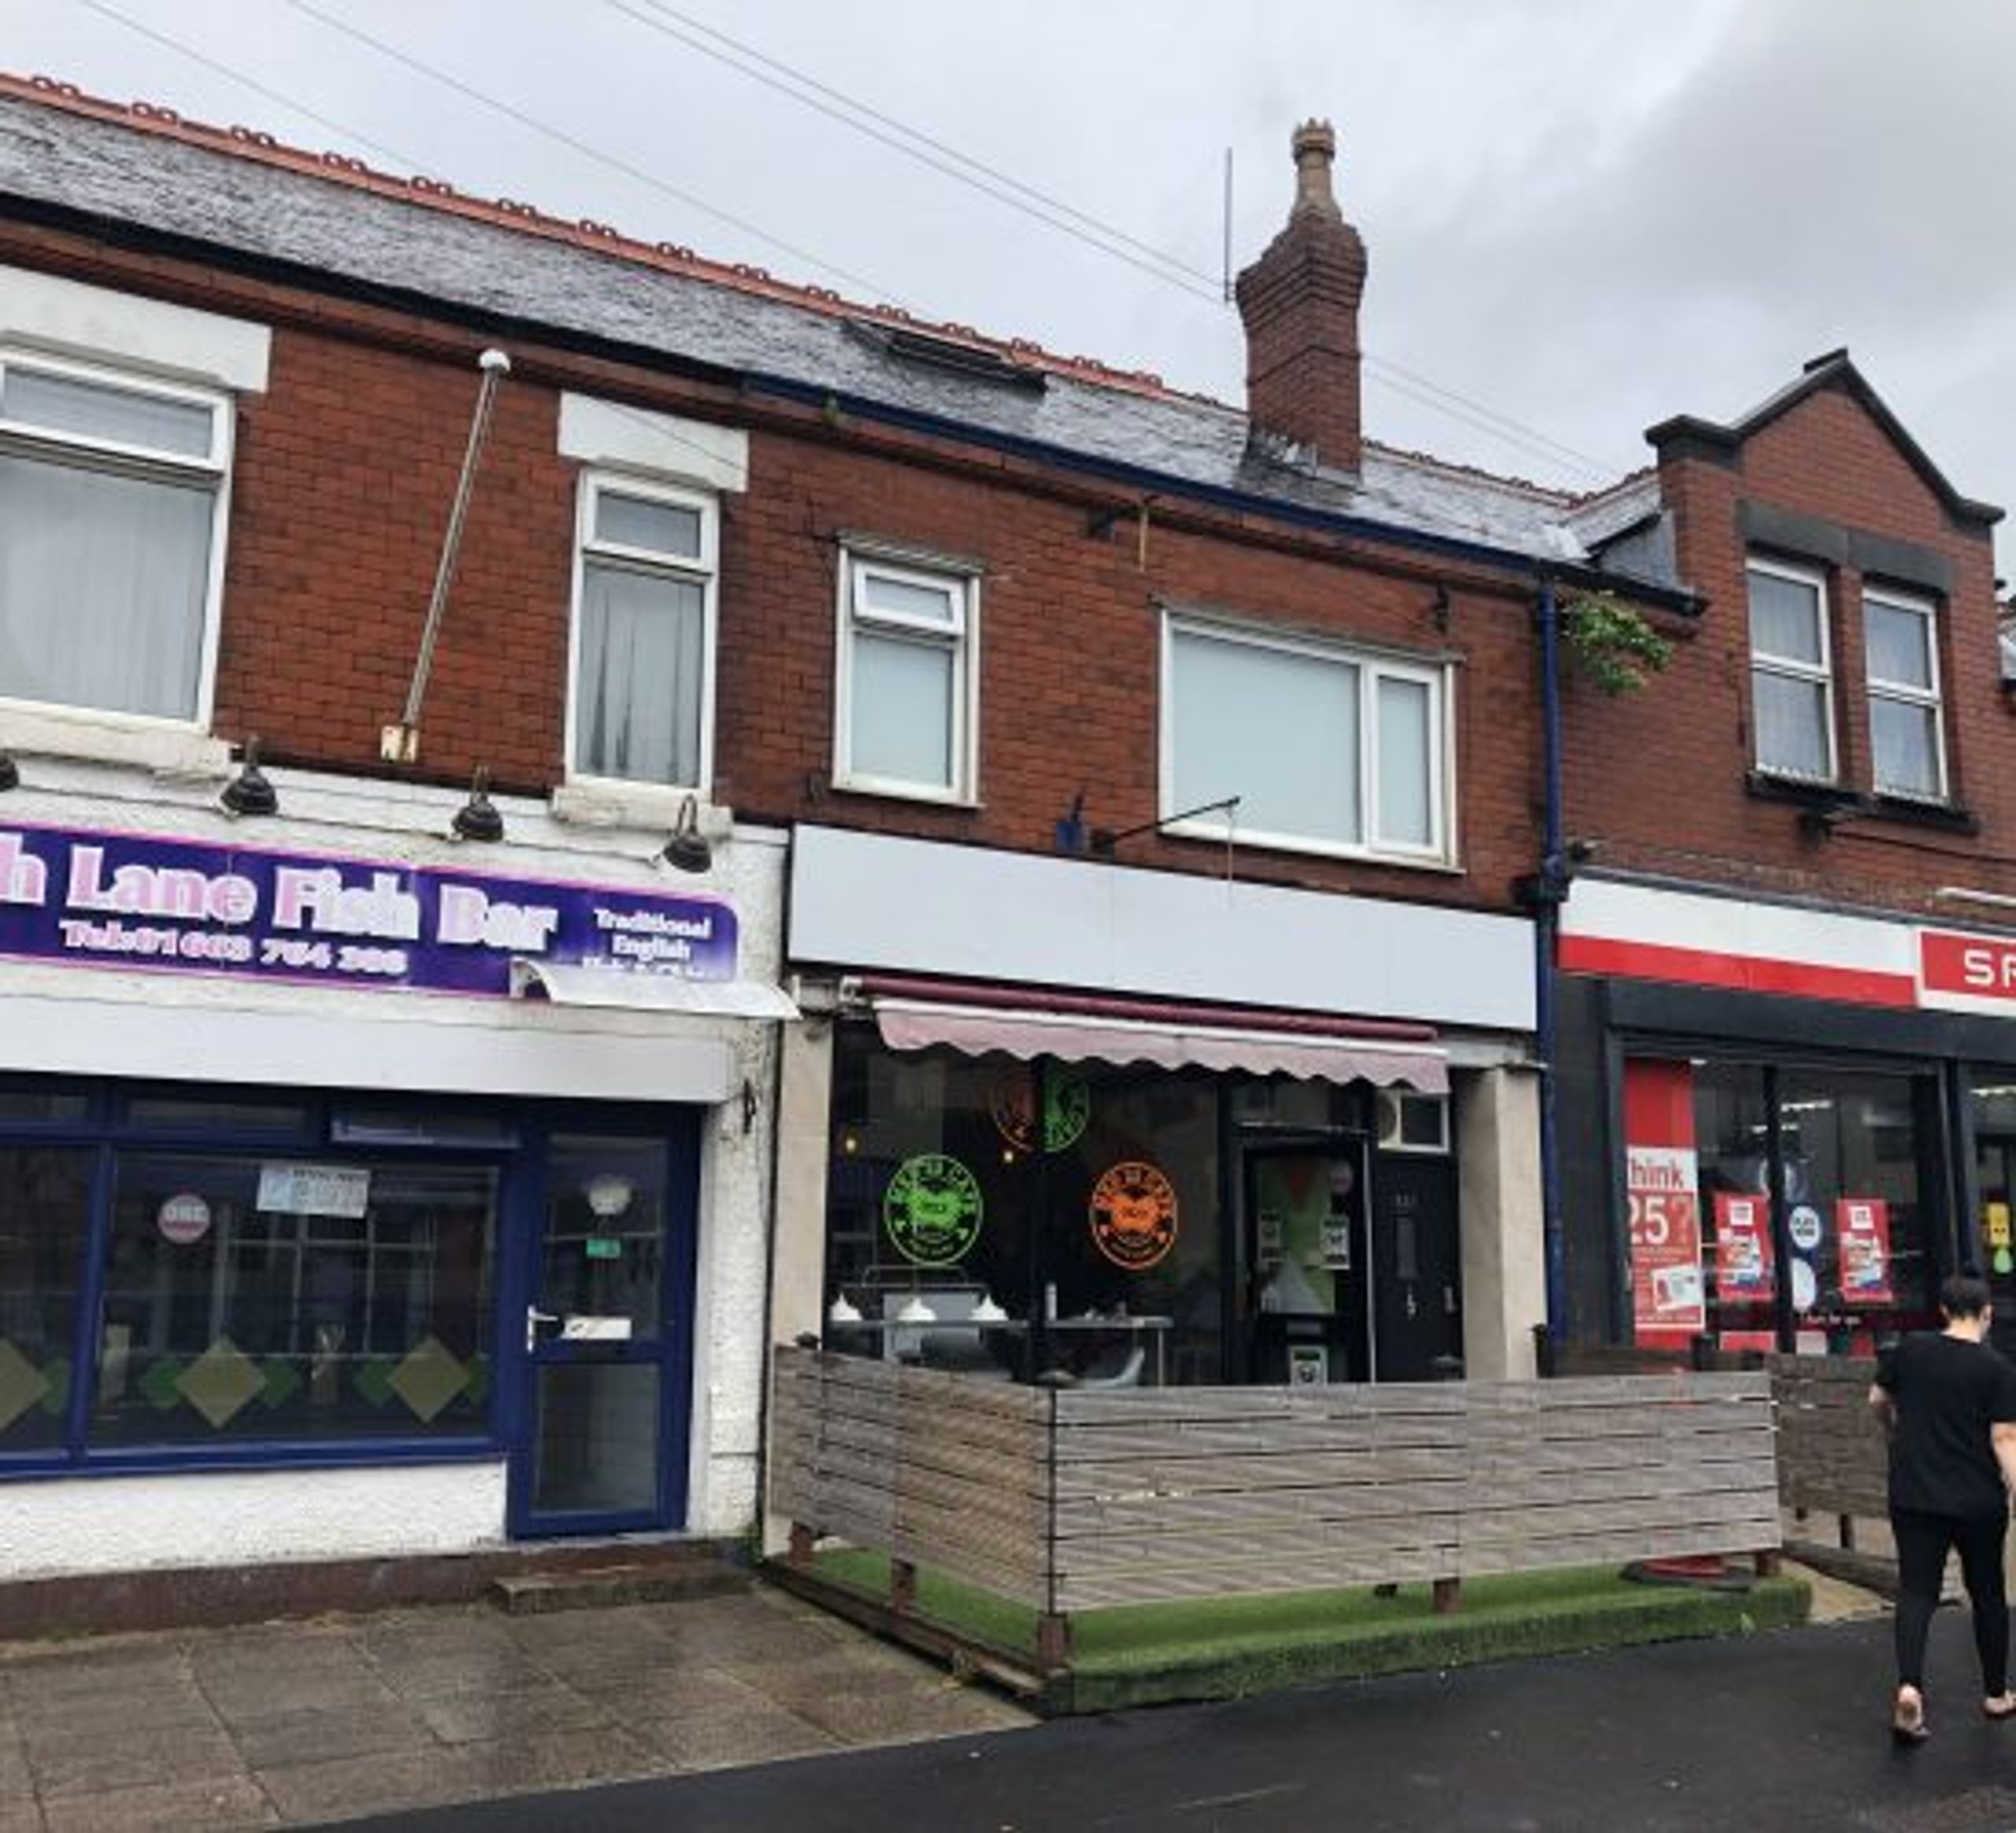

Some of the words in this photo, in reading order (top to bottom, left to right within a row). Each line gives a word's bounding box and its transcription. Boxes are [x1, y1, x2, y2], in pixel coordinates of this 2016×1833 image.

[0, 832, 46, 905] h
[66, 844, 258, 924] Lane
[272, 866, 420, 941] Fish
[436, 883, 558, 951] Bar
[594, 907, 712, 939] Traditional
[611, 934, 691, 963] English
[1631, 1158, 1684, 1189] hink
